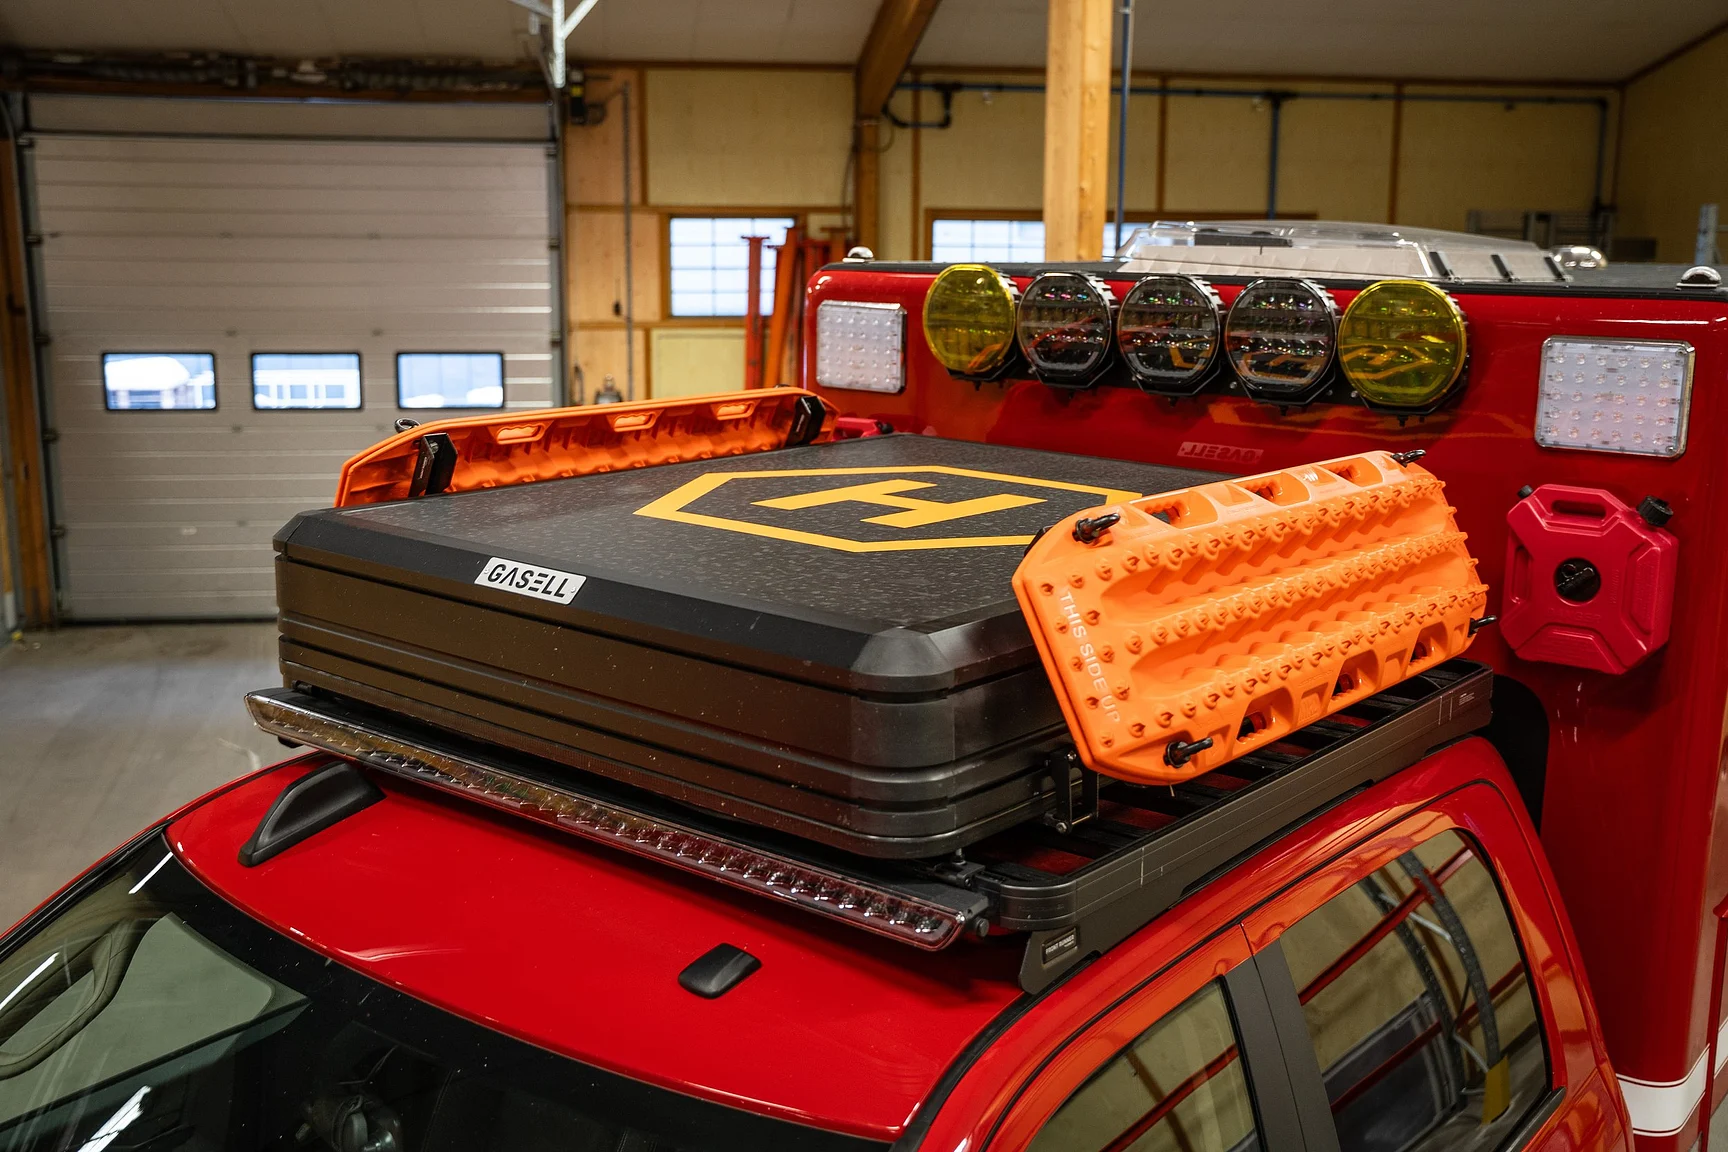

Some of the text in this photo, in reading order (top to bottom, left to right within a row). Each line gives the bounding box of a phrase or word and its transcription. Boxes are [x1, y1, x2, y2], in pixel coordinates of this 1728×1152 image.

[487, 563, 569, 598] GASELL
[1060, 591, 1121, 723] THIS SIDE UP
